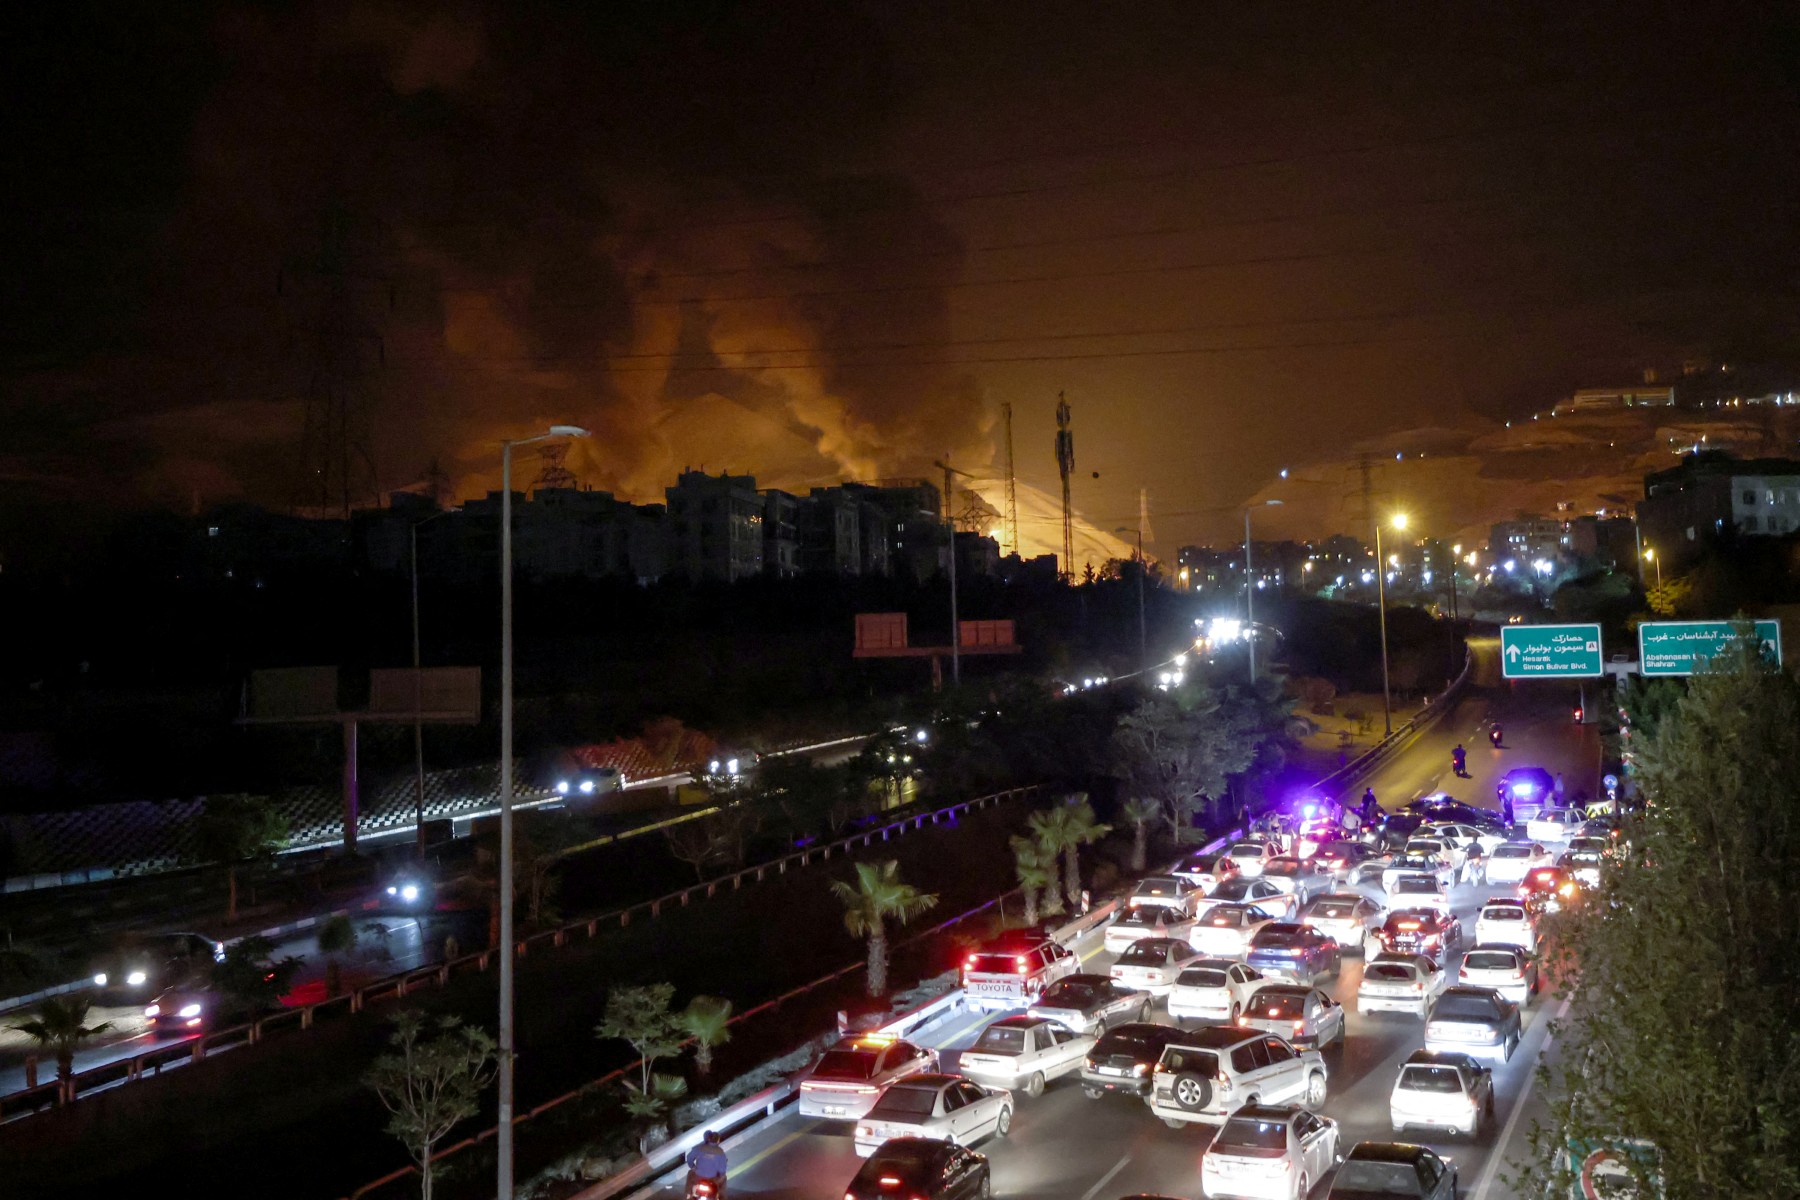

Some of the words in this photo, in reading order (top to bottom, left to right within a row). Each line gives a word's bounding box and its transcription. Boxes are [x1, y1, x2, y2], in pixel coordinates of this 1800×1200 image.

[1647, 632, 1668, 643] غرب
[1676, 631, 1718, 641] آبشناسان
[1523, 644, 1552, 654] بولیوار
[1554, 644, 1584, 654] سیمون
[1570, 662, 1588, 670] Blvd.
[976, 983, 1012, 992] TOYOTA
